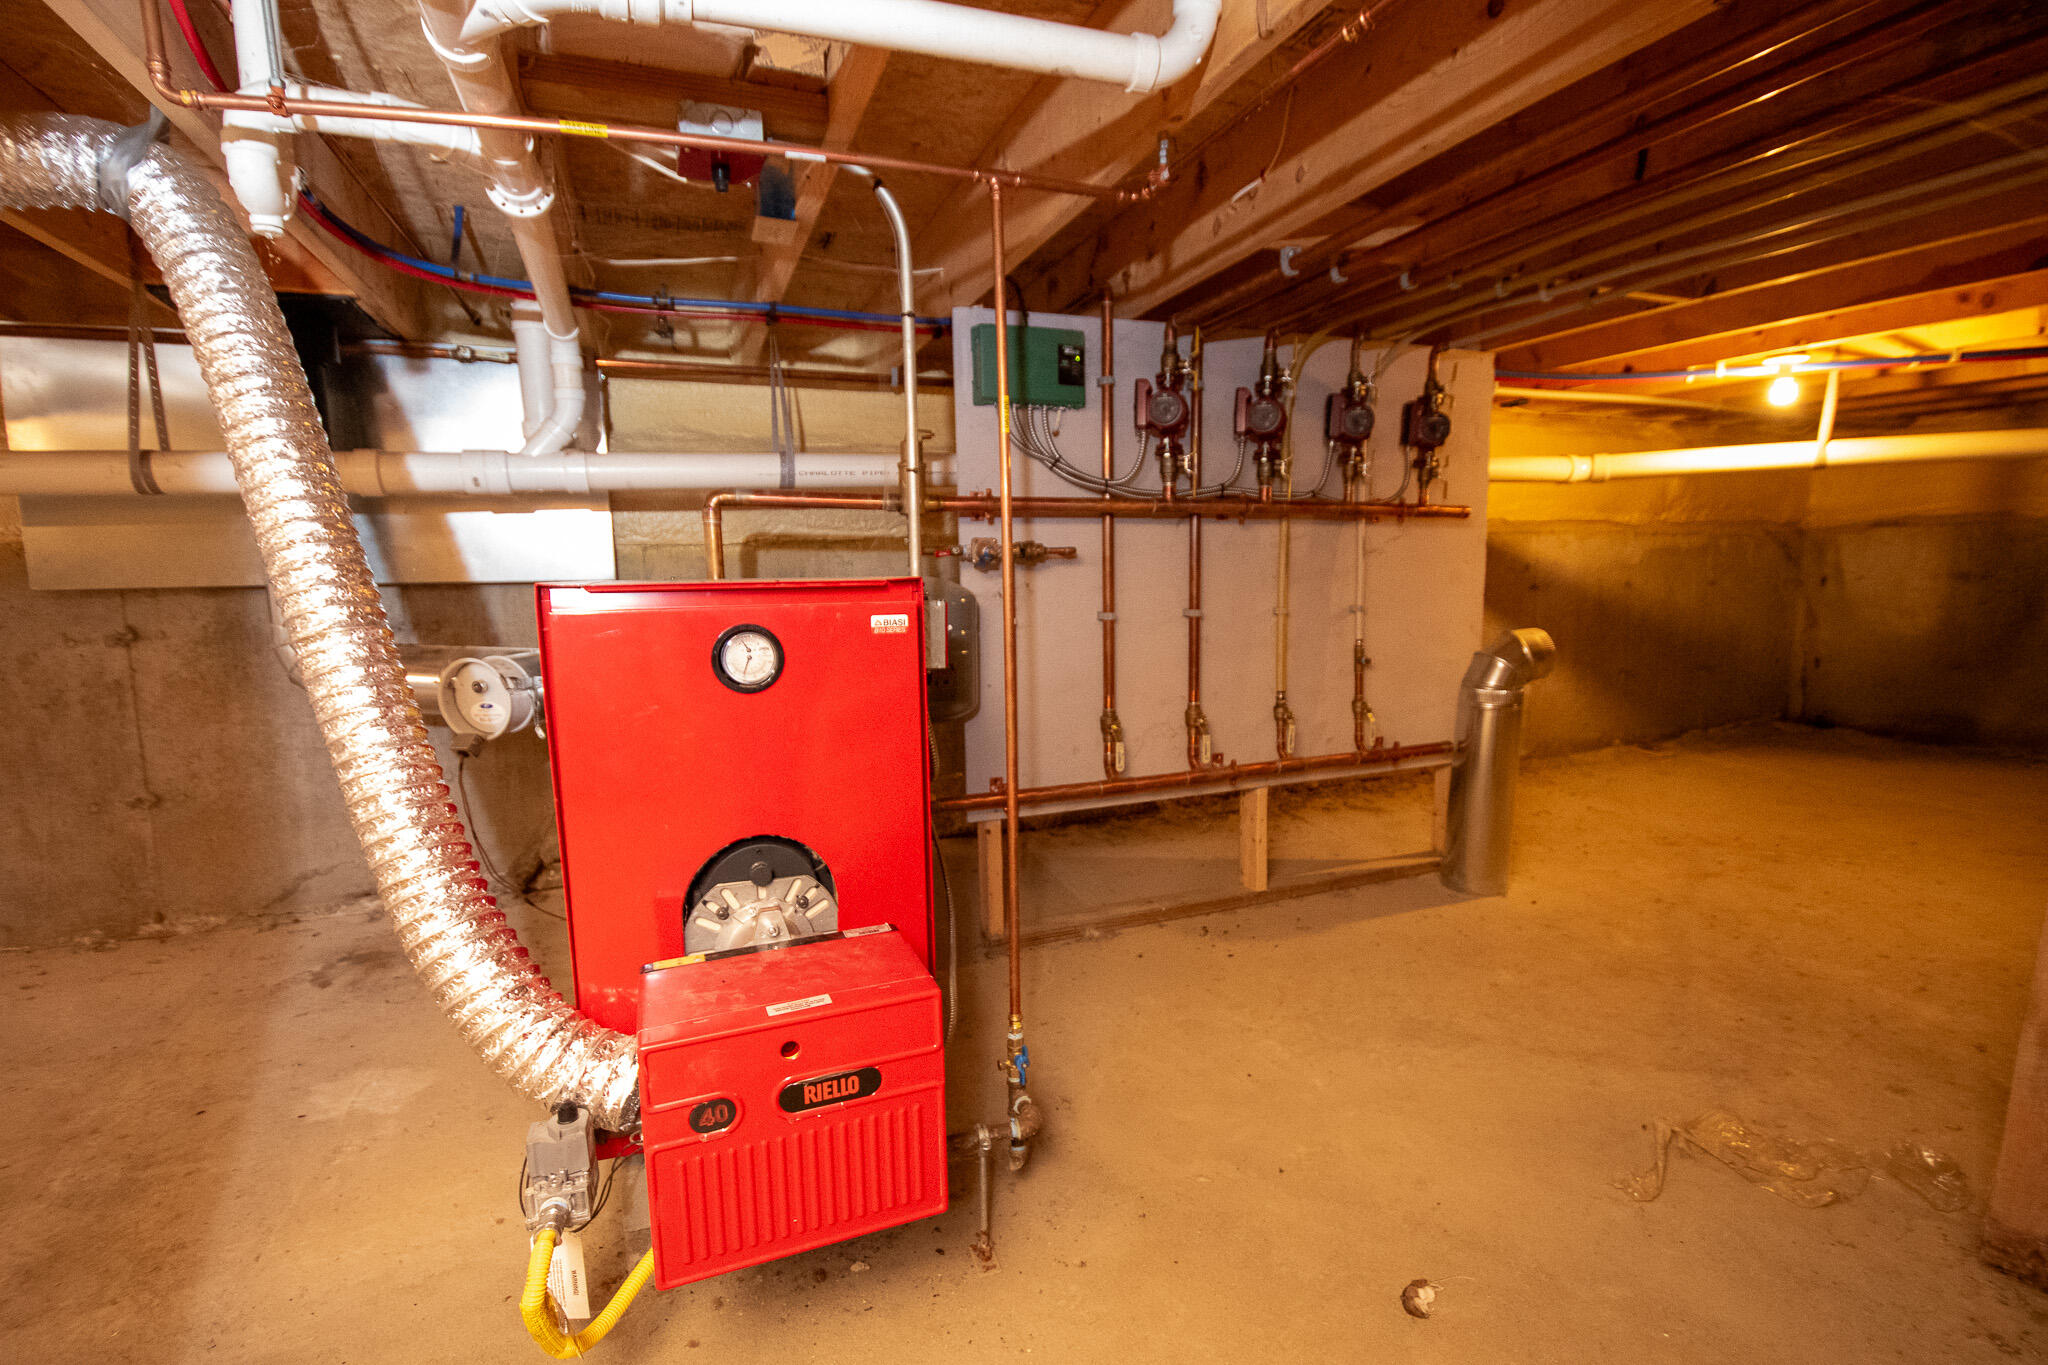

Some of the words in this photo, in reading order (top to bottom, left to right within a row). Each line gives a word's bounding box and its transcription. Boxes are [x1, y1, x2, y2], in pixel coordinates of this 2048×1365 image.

[883, 618, 906, 626] BIASI
[804, 1075, 860, 1104] RIELLO
[699, 1104, 728, 1126] 40
